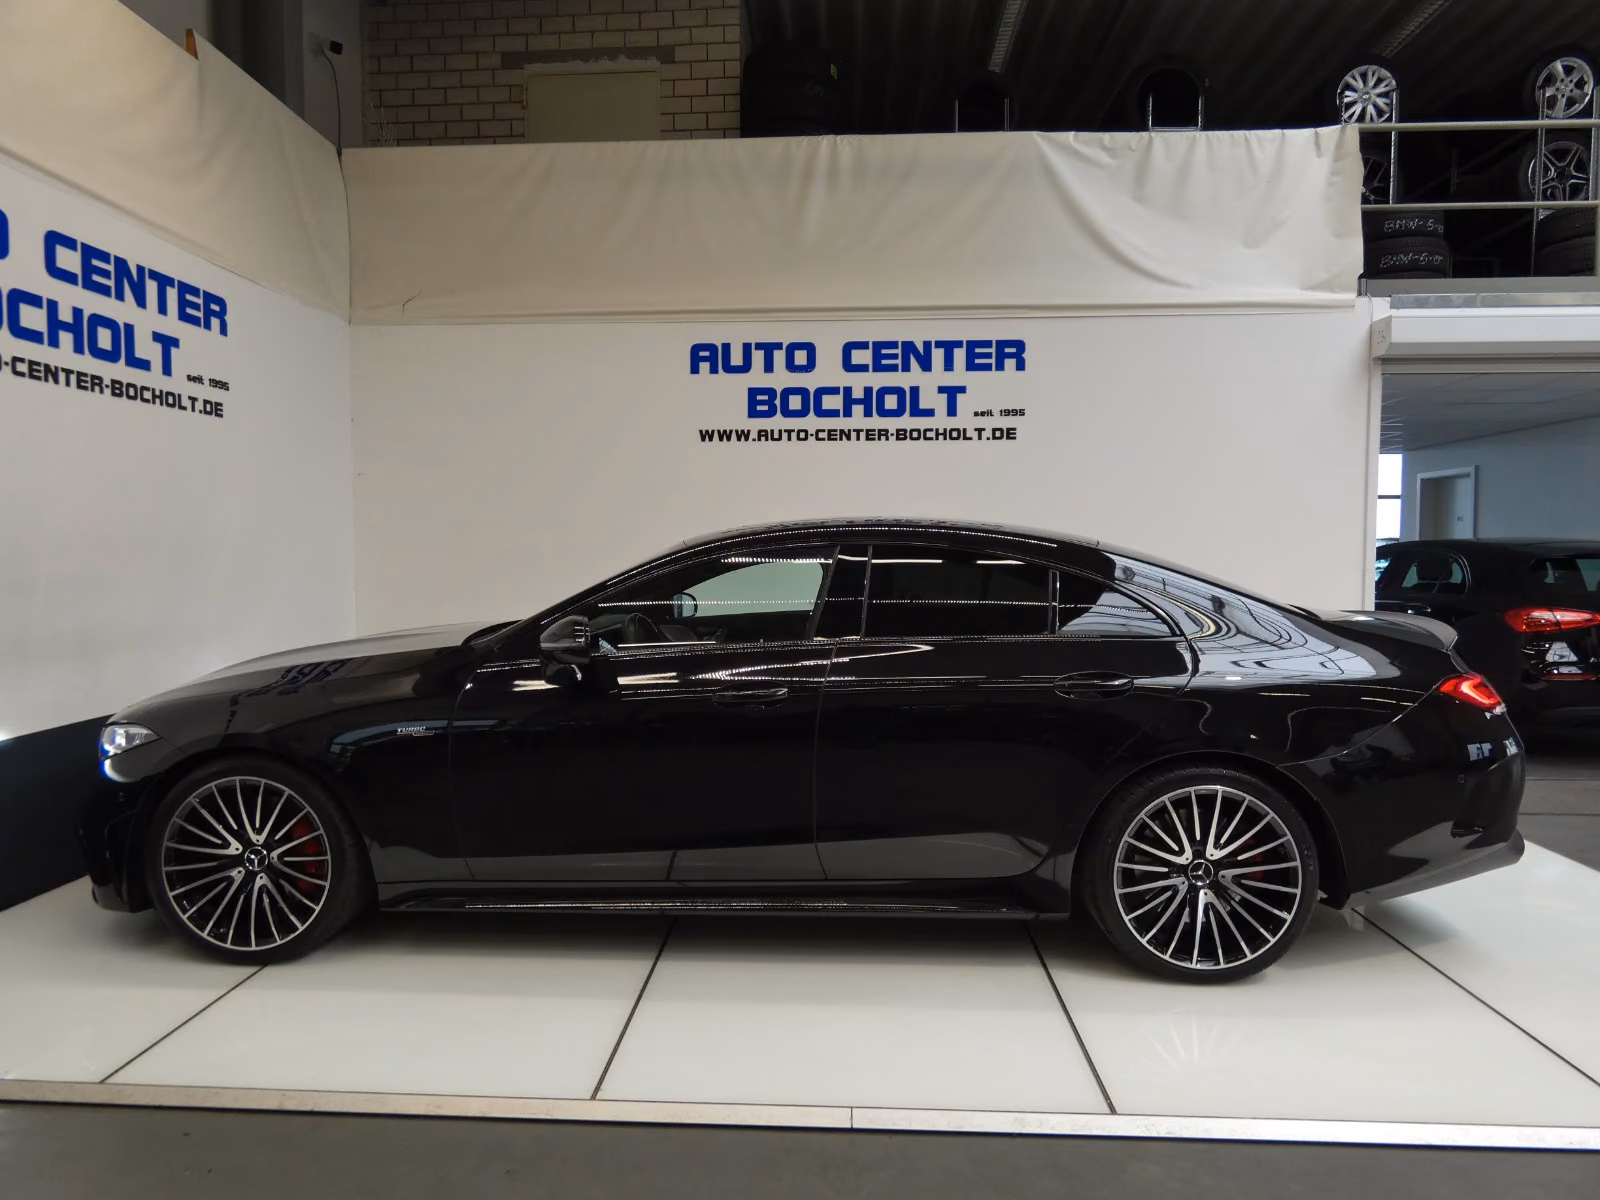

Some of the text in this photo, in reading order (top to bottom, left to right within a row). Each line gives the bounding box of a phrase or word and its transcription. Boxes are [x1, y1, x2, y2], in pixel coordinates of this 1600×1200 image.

[44, 229, 228, 337] CENTER
[0, 286, 180, 378] CHOLT
[689, 339, 1026, 375] AUTO CENTER
[0, 354, 224, 418] -CENTER-BOCHOLT.DE
[186, 374, 230, 392] seit 1995
[747, 385, 967, 419] BOCHOLT
[973, 408, 1026, 417] seit 1995
[698, 426, 1017, 443] WWW.AUTO-CENTER-BOCHOLT.DE
